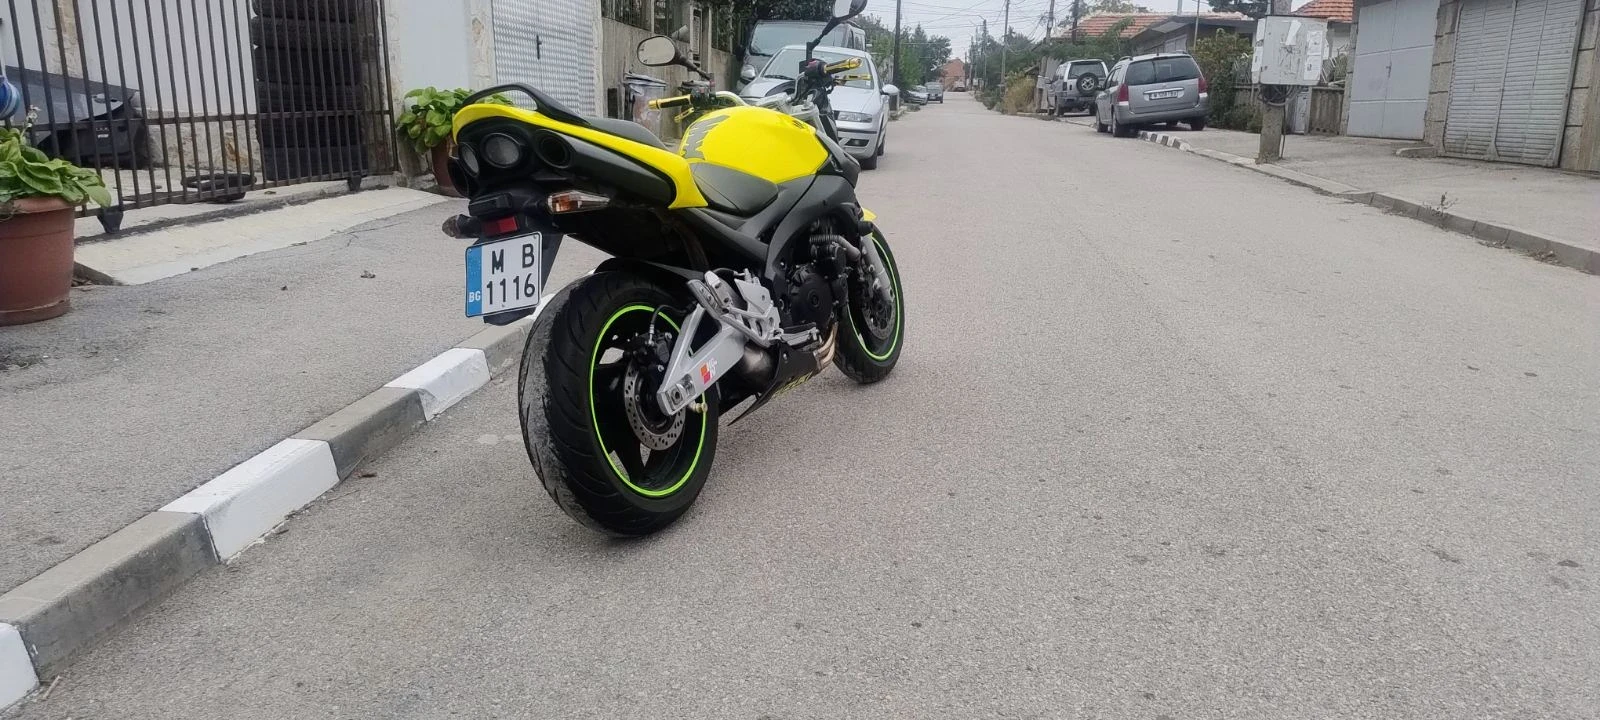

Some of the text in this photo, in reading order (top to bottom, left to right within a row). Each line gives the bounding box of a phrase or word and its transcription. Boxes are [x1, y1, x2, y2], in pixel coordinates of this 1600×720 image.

[491, 243, 535, 275] M B
[468, 290, 481, 303] BG
[486, 272, 536, 305] 1116
